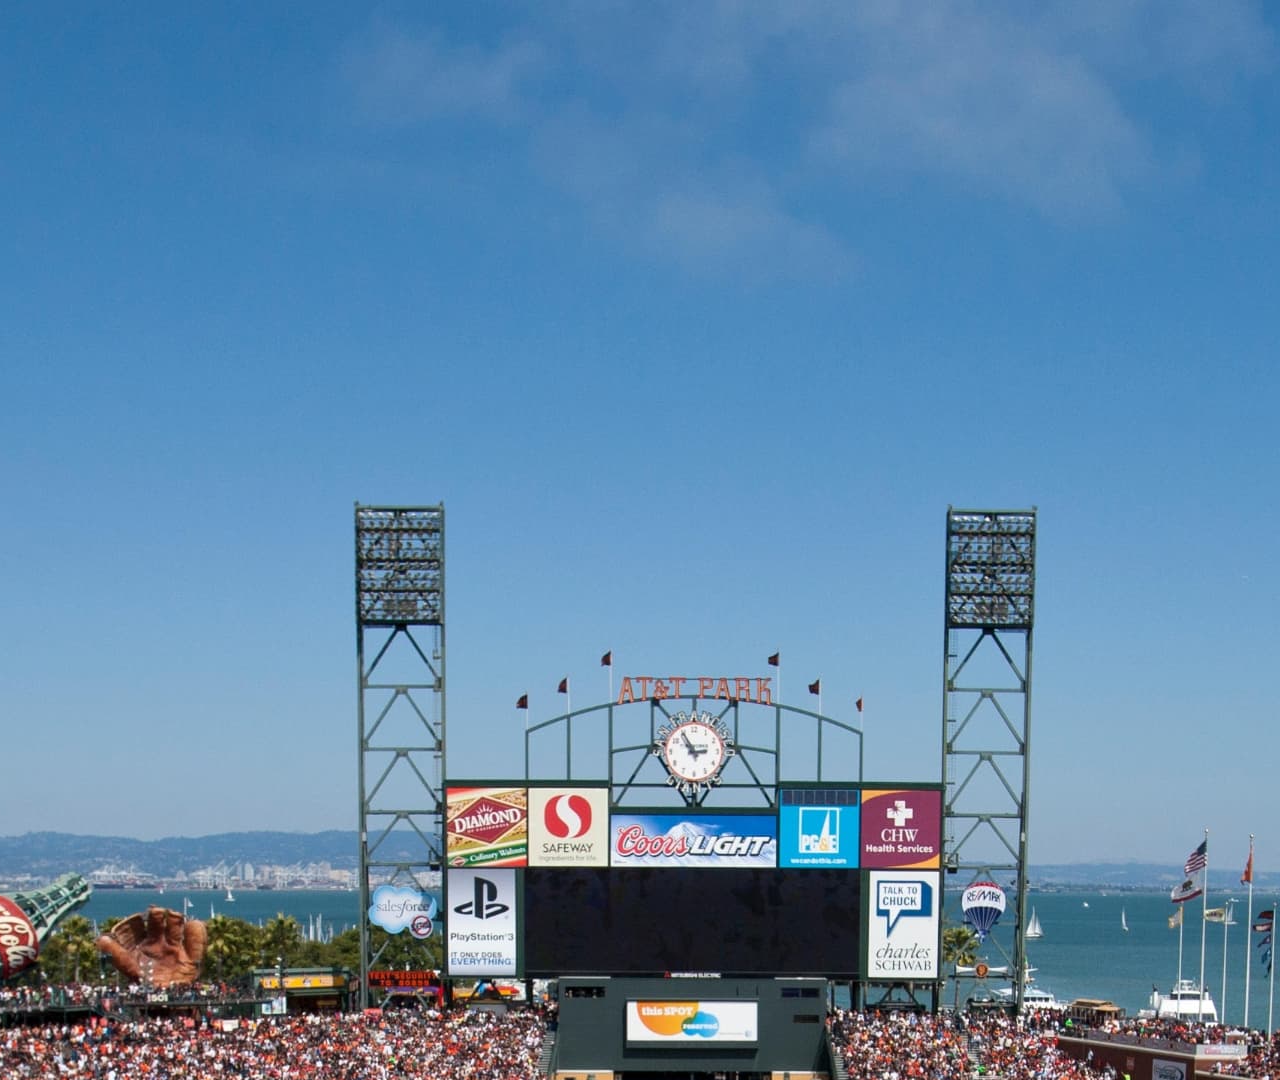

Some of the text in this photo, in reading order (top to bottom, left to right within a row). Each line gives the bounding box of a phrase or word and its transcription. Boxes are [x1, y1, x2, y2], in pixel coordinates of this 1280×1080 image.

[618, 676, 772, 706] AT&T PARK
[652, 710, 736, 757] SAN FRANCISCO
[666, 774, 723, 793] GIANTS
[454, 807, 520, 833] DIAMOND
[616, 824, 770, 857] Coors LIGHT
[801, 833, 837, 851] PG&E
[881, 828, 919, 842] CHW
[543, 843, 593, 853] SAFEWAY
[866, 844, 933, 853] Health Services
[883, 886, 917, 894] TALK TO
[966, 889, 1002, 903] RE/MAX
[376, 899, 430, 917] salesforce
[882, 897, 917, 906] CHUCK
[876, 943, 930, 959] charles
[875, 960, 932, 970] SCHWAB
[642, 1005, 694, 1016] this SPOT
[683, 1022, 718, 1031] reserved
